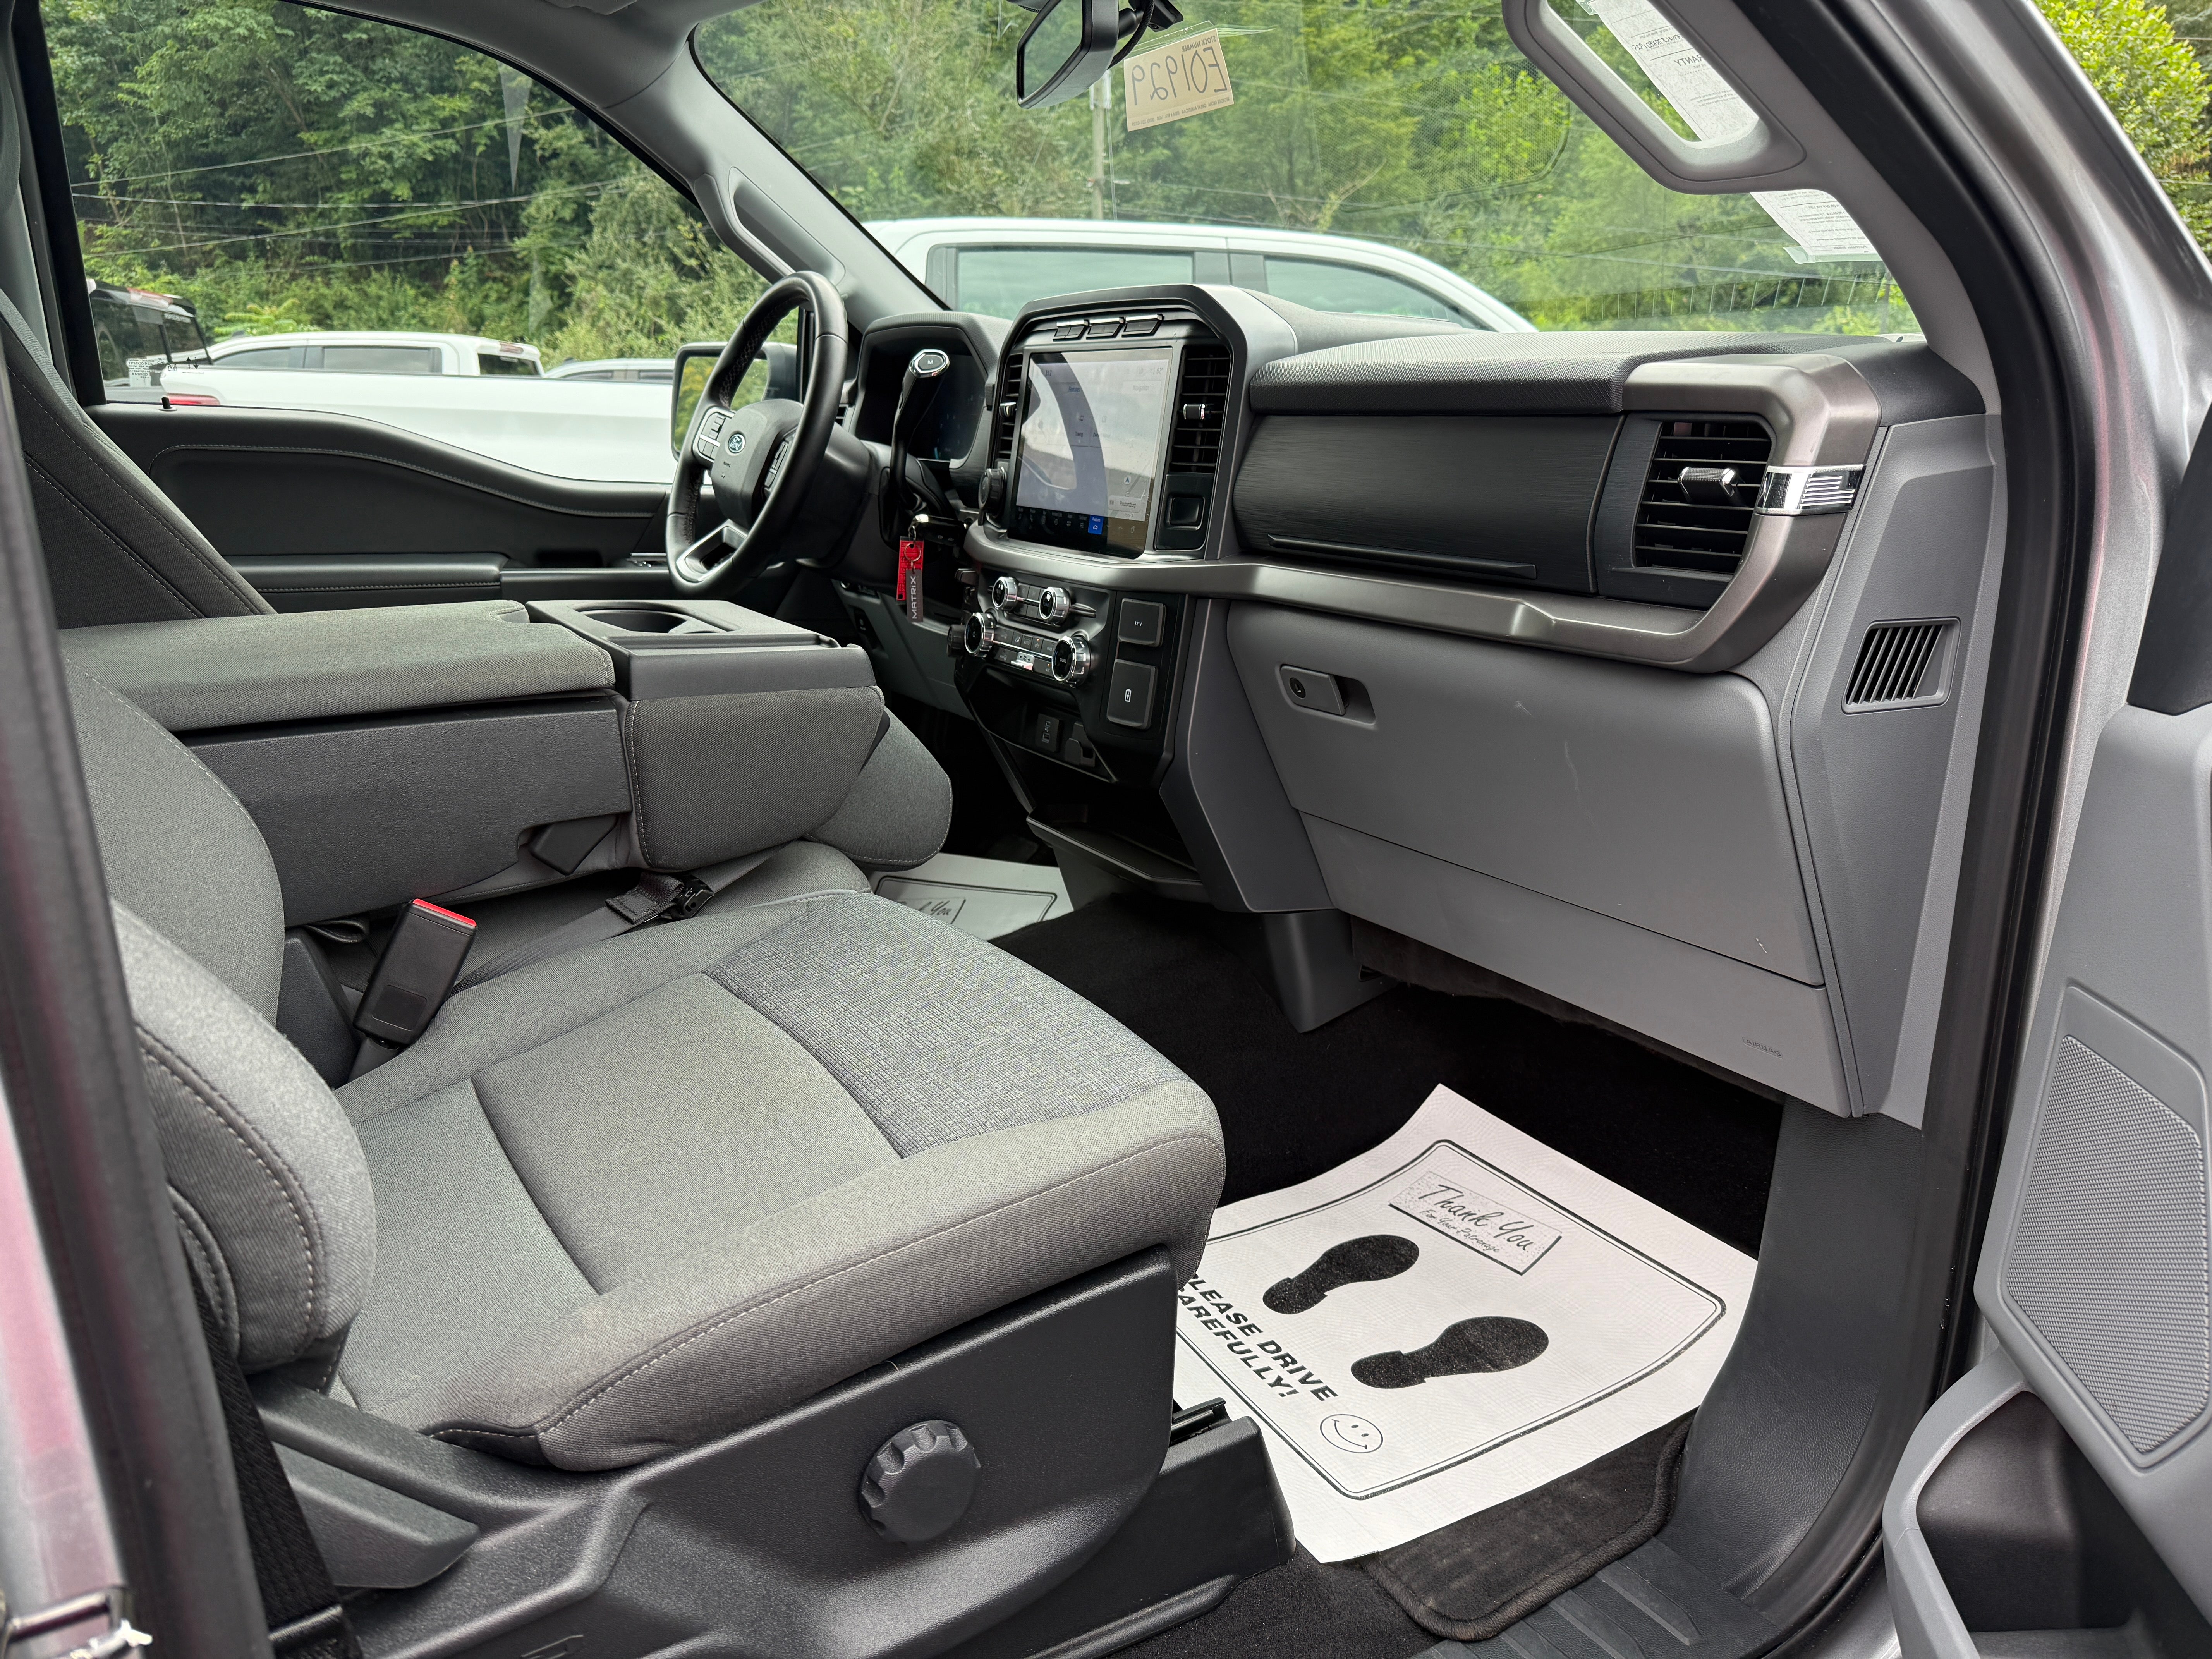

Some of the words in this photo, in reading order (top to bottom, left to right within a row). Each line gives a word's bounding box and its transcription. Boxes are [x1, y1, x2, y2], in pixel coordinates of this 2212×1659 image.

[1746, 1039, 1781, 1057] AIRBAG
[1418, 1184, 1504, 1227] Thank
[1493, 1221, 1534, 1251] You
[1420, 1209, 1436, 1219] For
[1439, 1218, 1458, 1230] Your
[1456, 1228, 1502, 1252] Patronage
[1178, 1288, 1299, 1398] AREFULLY!
[1188, 1274, 1263, 1337] LEASE
[1257, 1340, 1339, 1401] DRIVE
